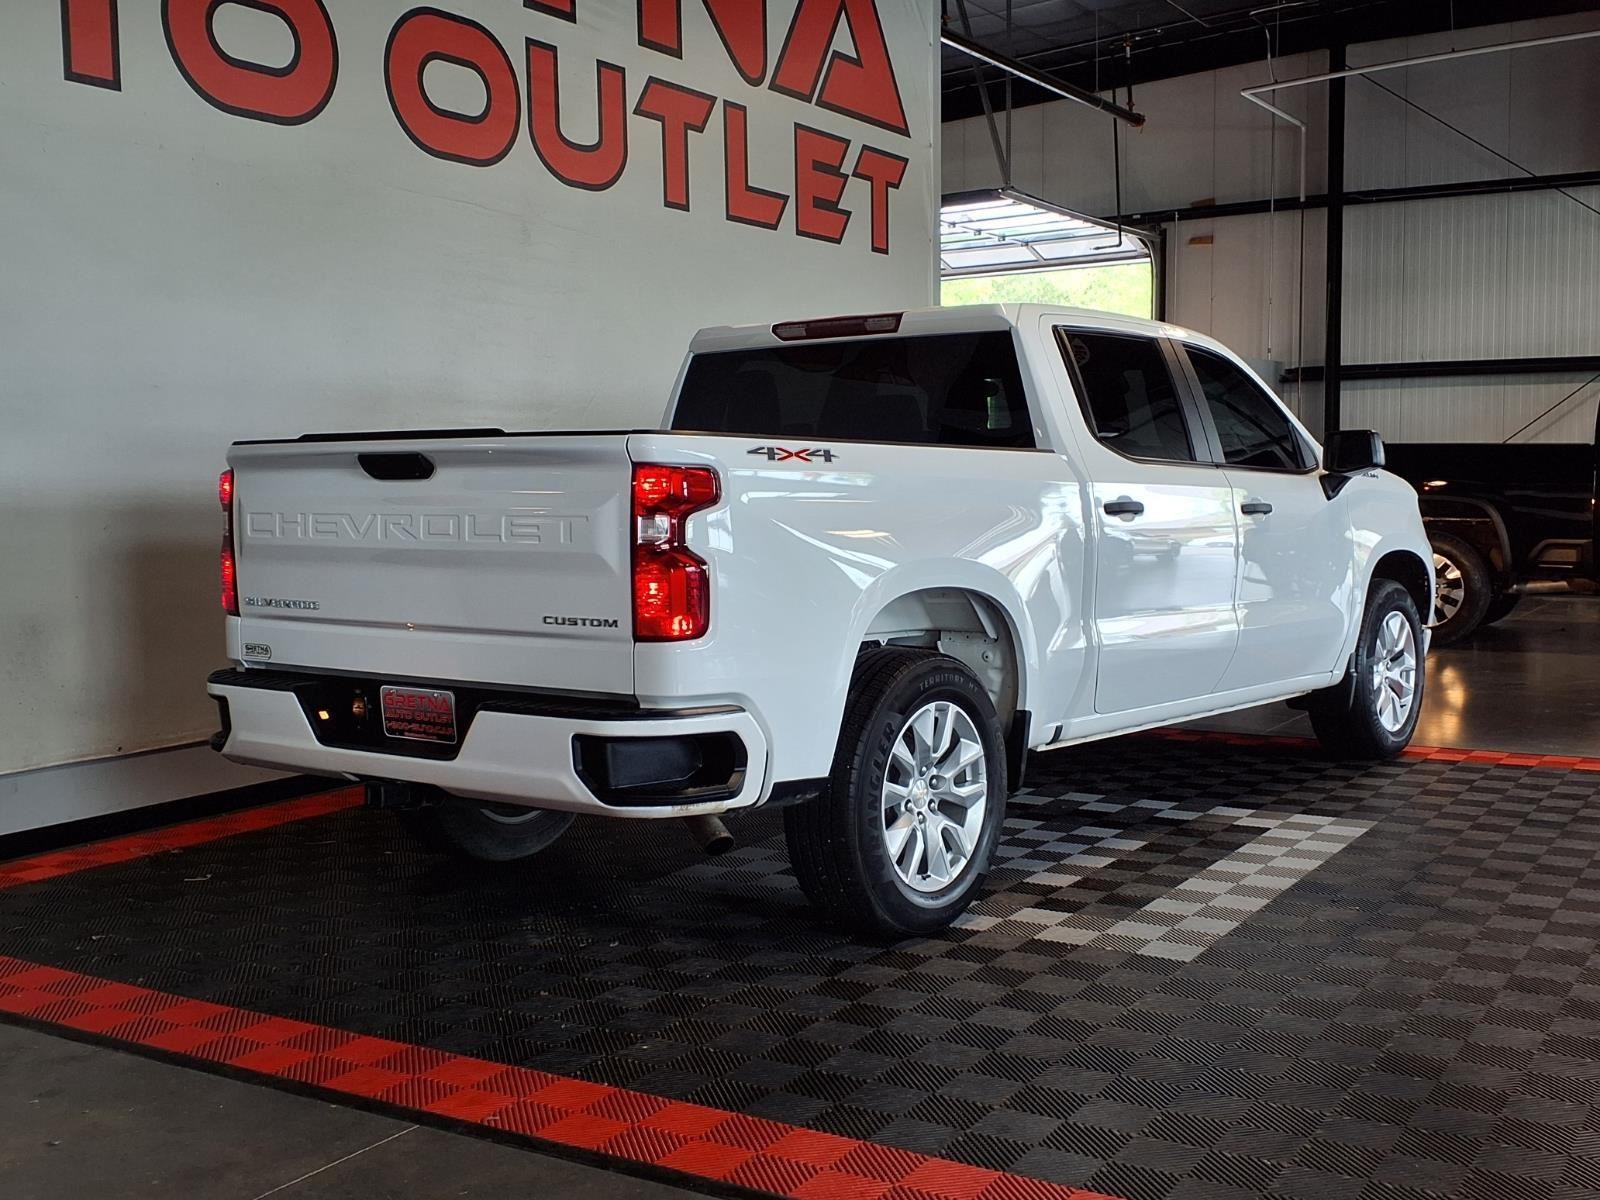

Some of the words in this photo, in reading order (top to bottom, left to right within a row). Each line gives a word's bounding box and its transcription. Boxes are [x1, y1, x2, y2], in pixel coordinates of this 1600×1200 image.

[384, 6, 909, 255] OUTLET
[247, 512, 590, 544] CHEVROLET
[543, 615, 619, 628] CUSTOM
[919, 673, 965, 692] TERRITORY
[384, 691, 451, 712] GRETNA
